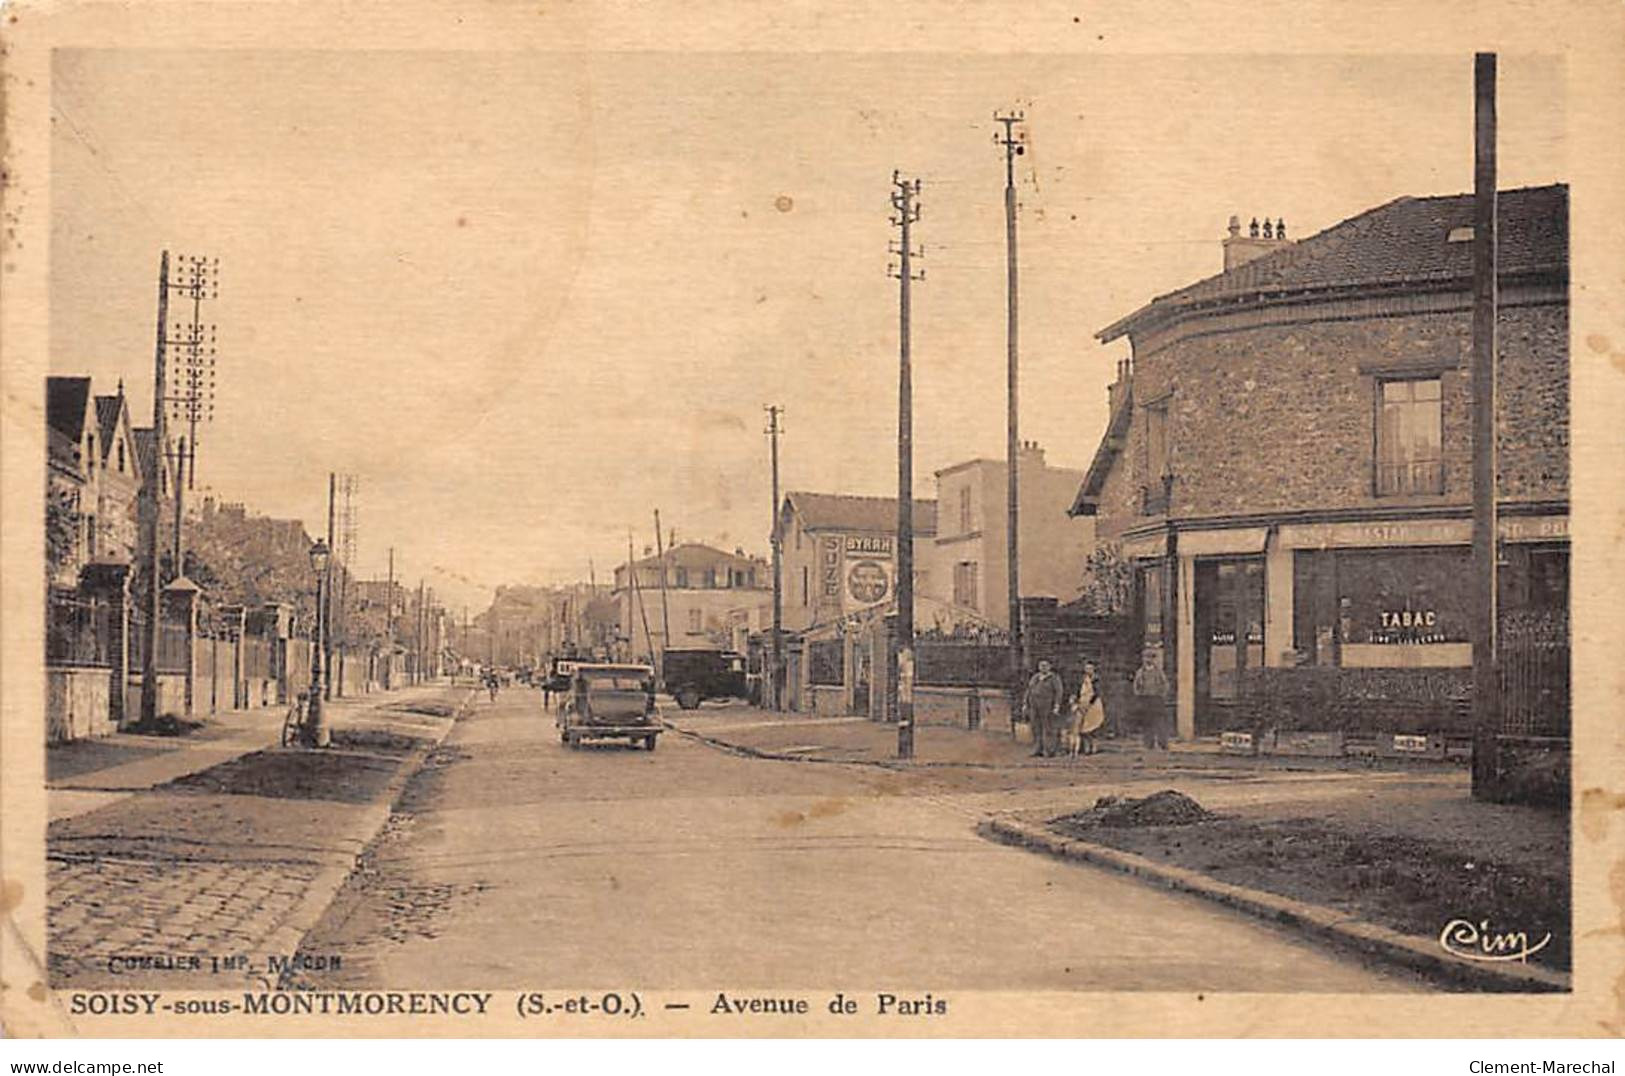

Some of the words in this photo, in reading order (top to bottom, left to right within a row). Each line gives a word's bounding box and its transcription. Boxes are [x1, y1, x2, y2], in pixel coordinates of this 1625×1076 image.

[846, 537, 891, 552] BYRRH
[825, 537, 839, 597] SUZE
[1381, 610, 1436, 627] TABAC
